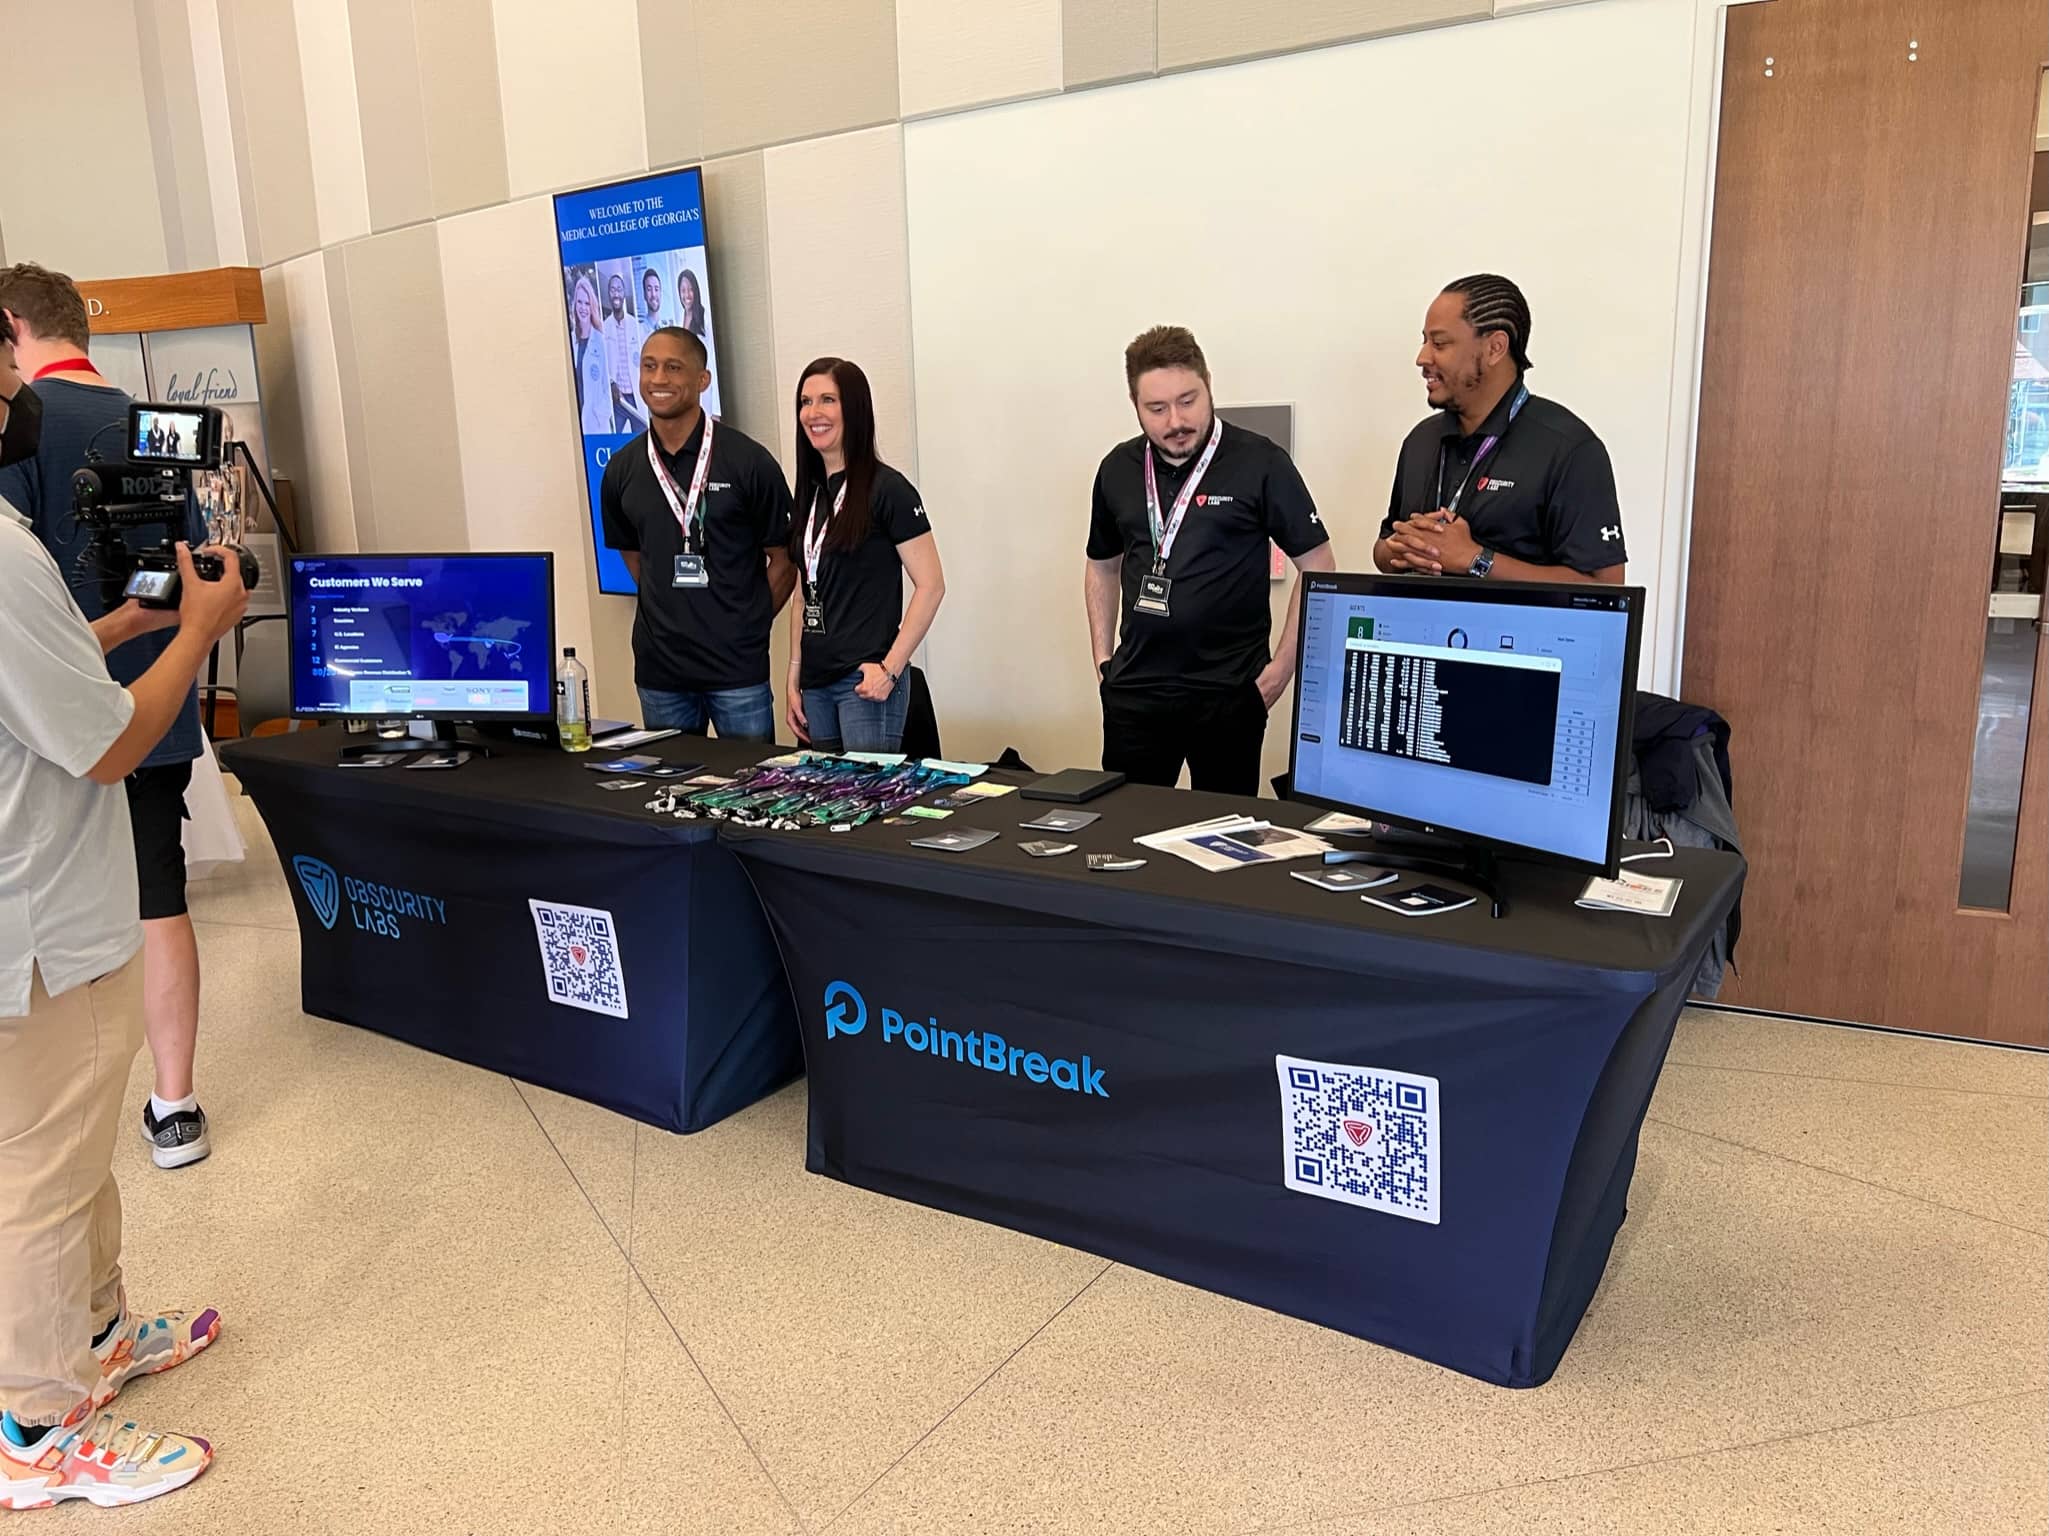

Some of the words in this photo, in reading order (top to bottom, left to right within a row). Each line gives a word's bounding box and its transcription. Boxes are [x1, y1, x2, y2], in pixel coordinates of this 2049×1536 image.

[561, 225, 598, 242] MEDICAL
[598, 219, 639, 236] COLLEGE
[638, 217, 650, 230] OF
[651, 207, 701, 228] GEORGIA'S
[588, 203, 632, 220] WELCOME
[633, 199, 645, 213] TO
[645, 196, 664, 210] THE
[166, 372, 200, 405] loyal
[201, 367, 238, 406] friend
[309, 577, 370, 588] Customers
[370, 577, 390, 588] We
[390, 576, 423, 588] Serve
[310, 605, 316, 614] 7
[311, 629, 317, 638] 7
[344, 876, 447, 925] OBSCURITY
[352, 905, 401, 940] LABS
[881, 1007, 1110, 1098] PointBreak
